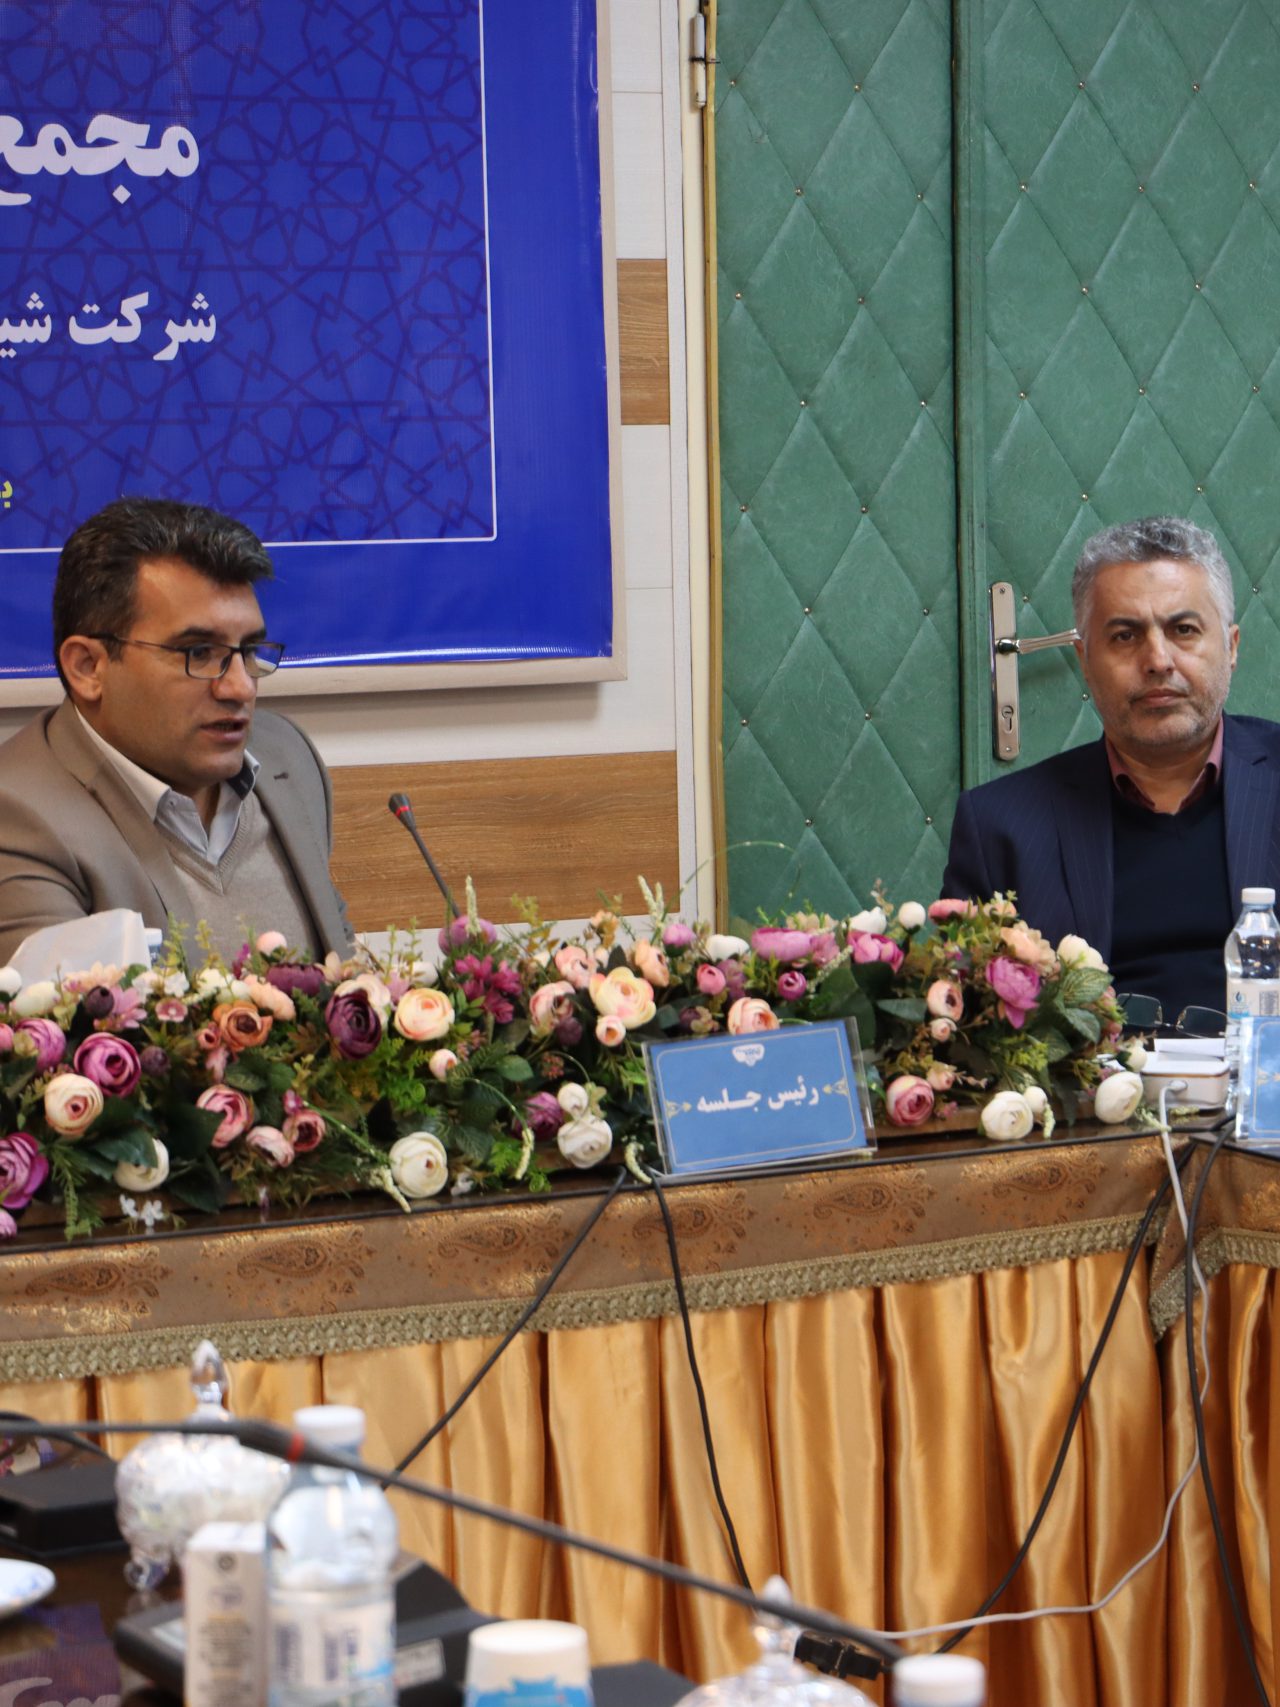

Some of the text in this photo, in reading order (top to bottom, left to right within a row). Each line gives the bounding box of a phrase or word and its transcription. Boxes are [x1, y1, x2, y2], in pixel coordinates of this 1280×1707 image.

[0, 291, 216, 361] شرکت شی
[697, 1074, 819, 1113] رئیس جلسه
